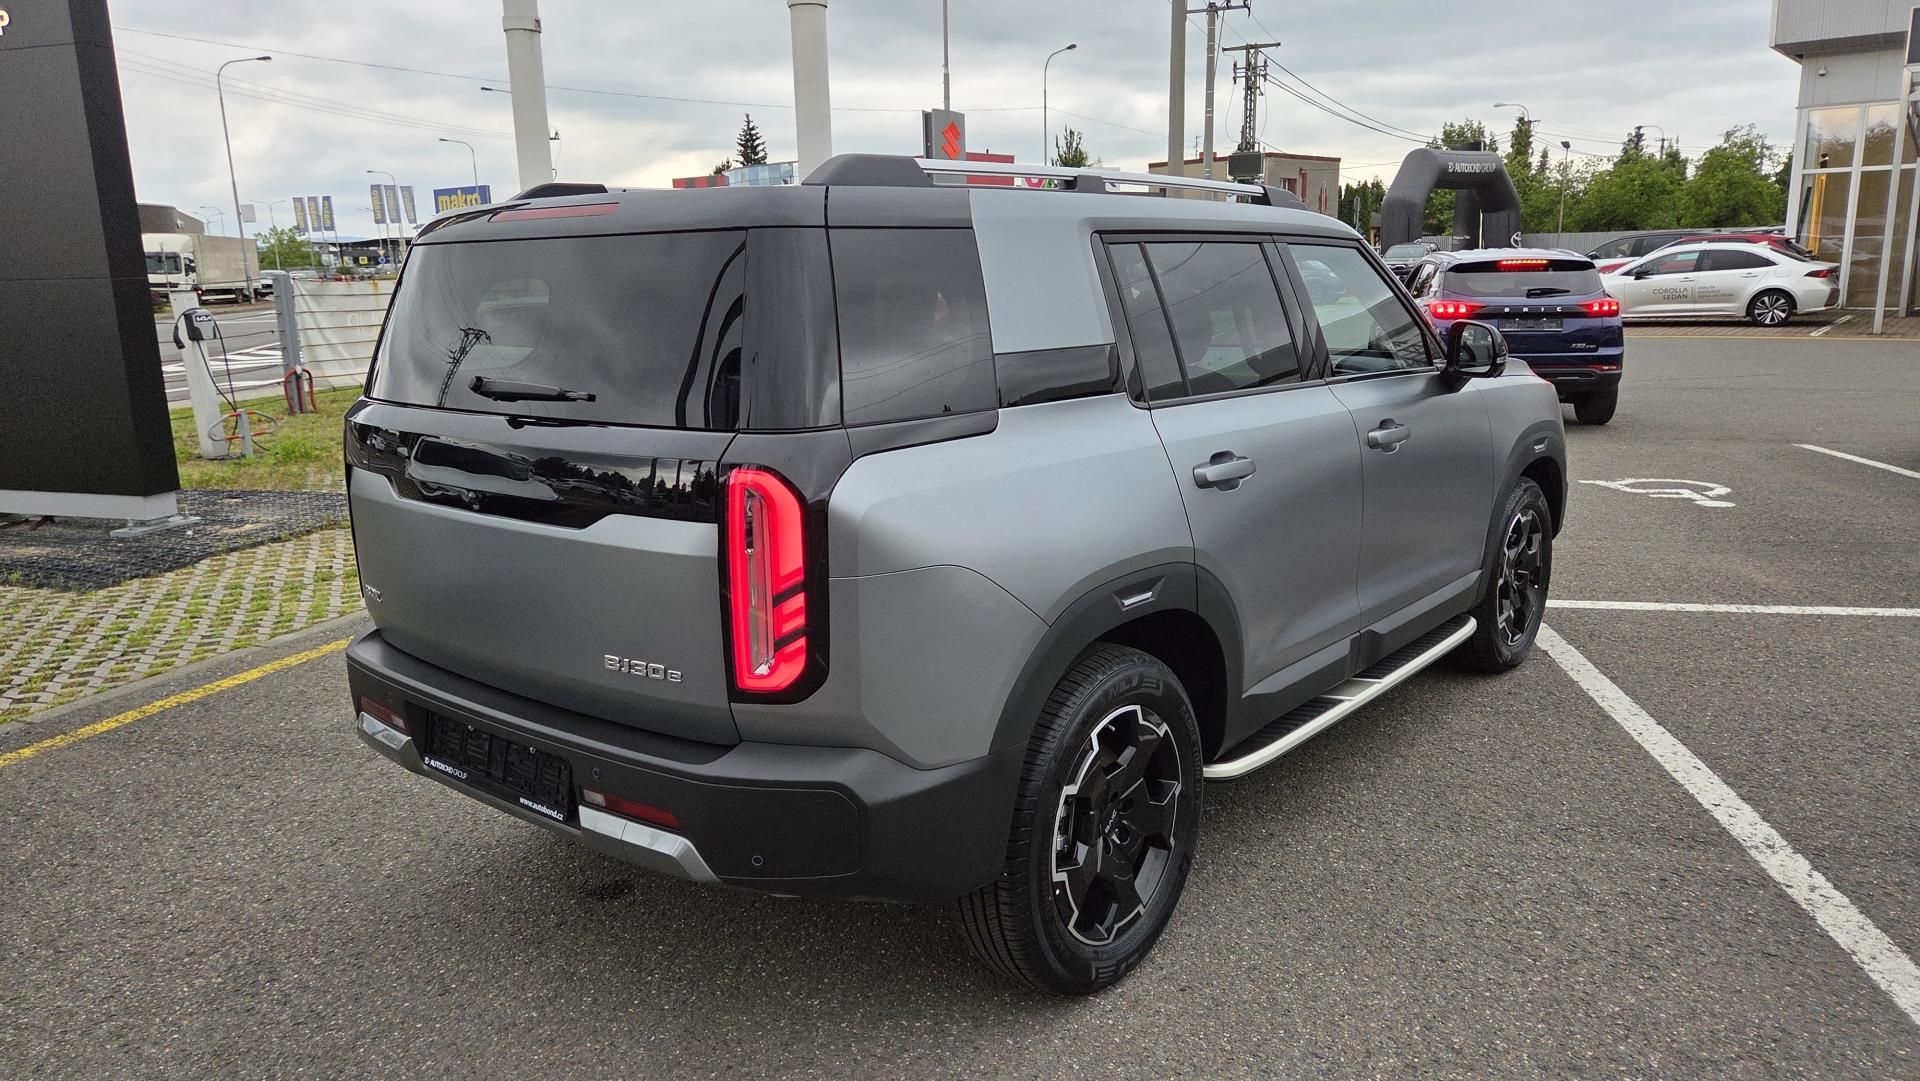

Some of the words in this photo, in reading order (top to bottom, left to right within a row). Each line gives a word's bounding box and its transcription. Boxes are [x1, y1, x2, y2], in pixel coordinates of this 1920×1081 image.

[438, 189, 481, 212] makro
[1652, 287, 1689, 295] COROLLA
[519, 796, 564, 821] www.autobond.cz
